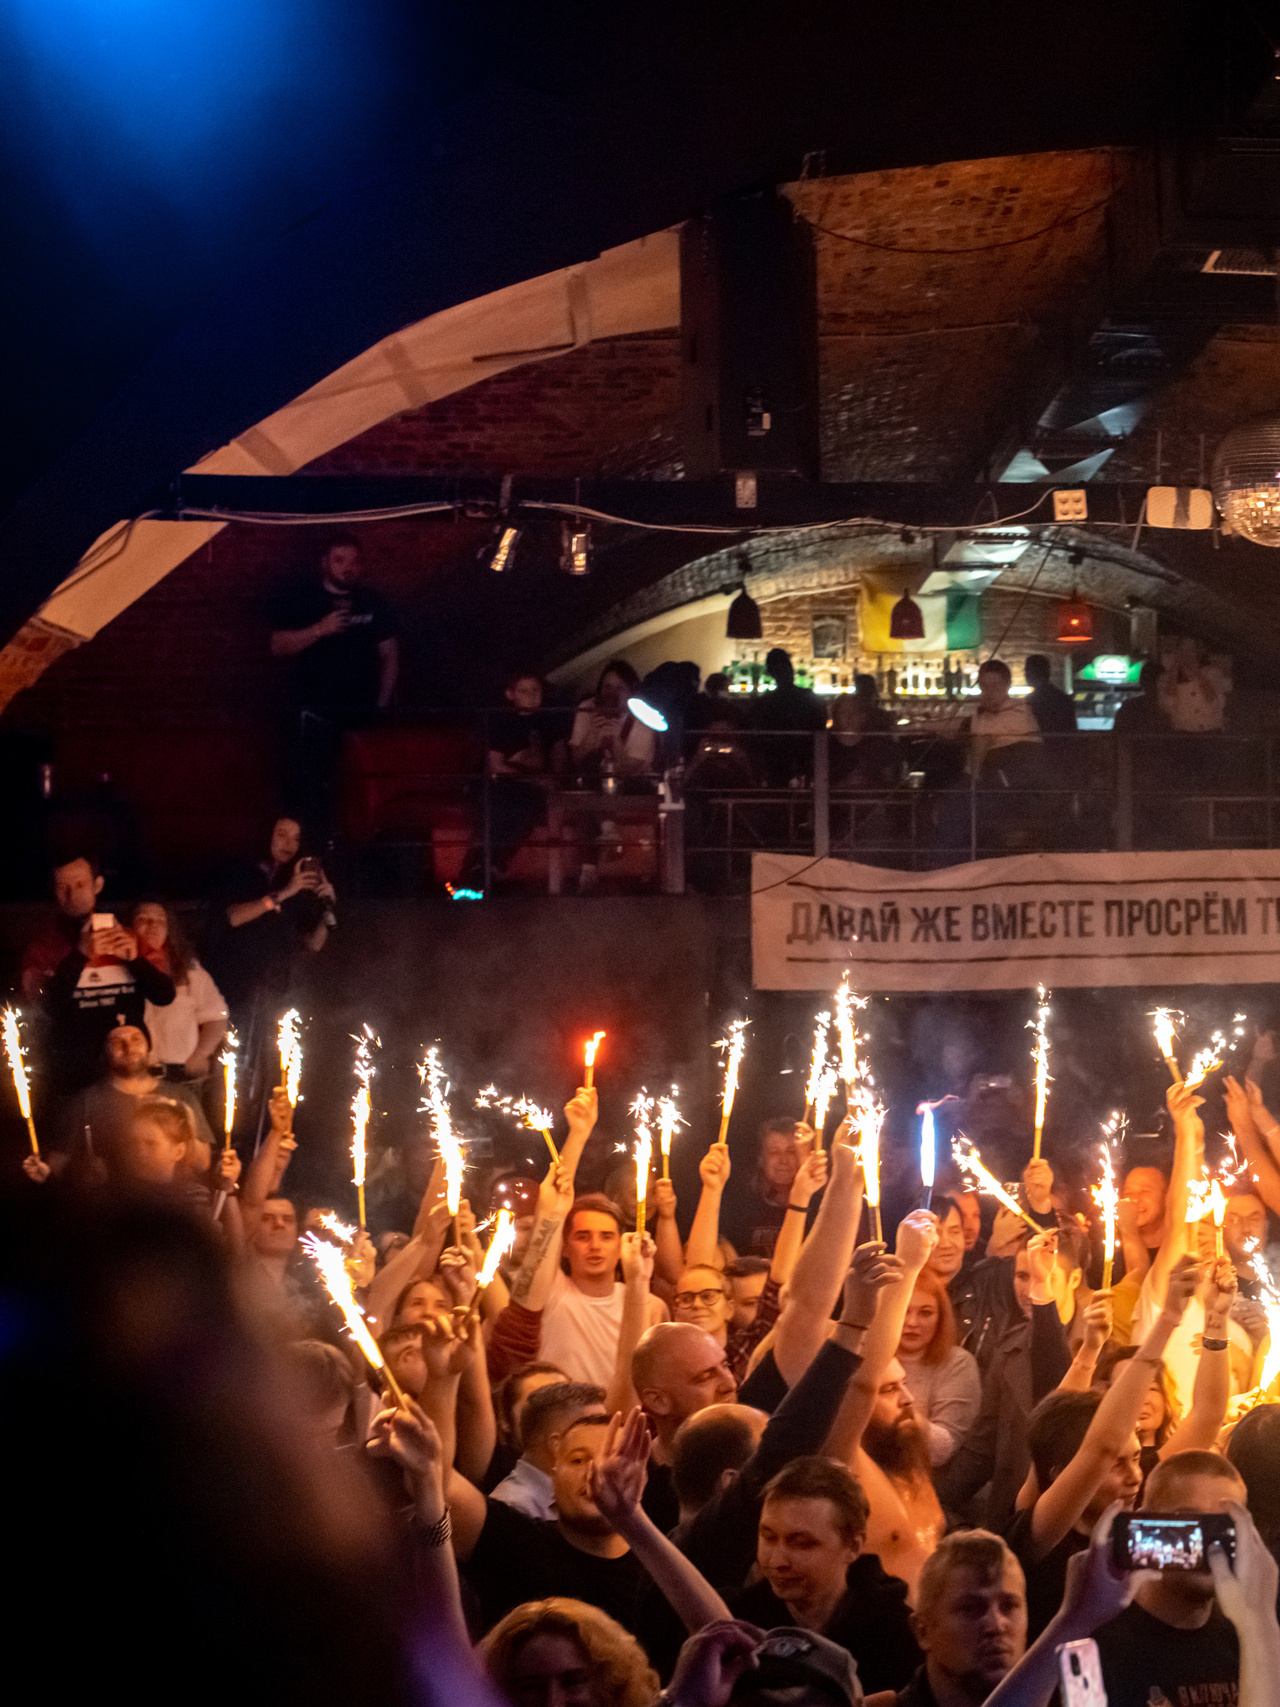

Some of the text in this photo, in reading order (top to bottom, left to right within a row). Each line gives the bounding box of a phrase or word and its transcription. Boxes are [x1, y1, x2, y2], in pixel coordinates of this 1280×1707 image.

[786, 901, 901, 945] ДАВАЙ
[910, 905, 962, 943] ЖЕ
[970, 900, 1095, 942] ВМЕСТЕ
[1104, 891, 1248, 938] ПРОСРЁМ
